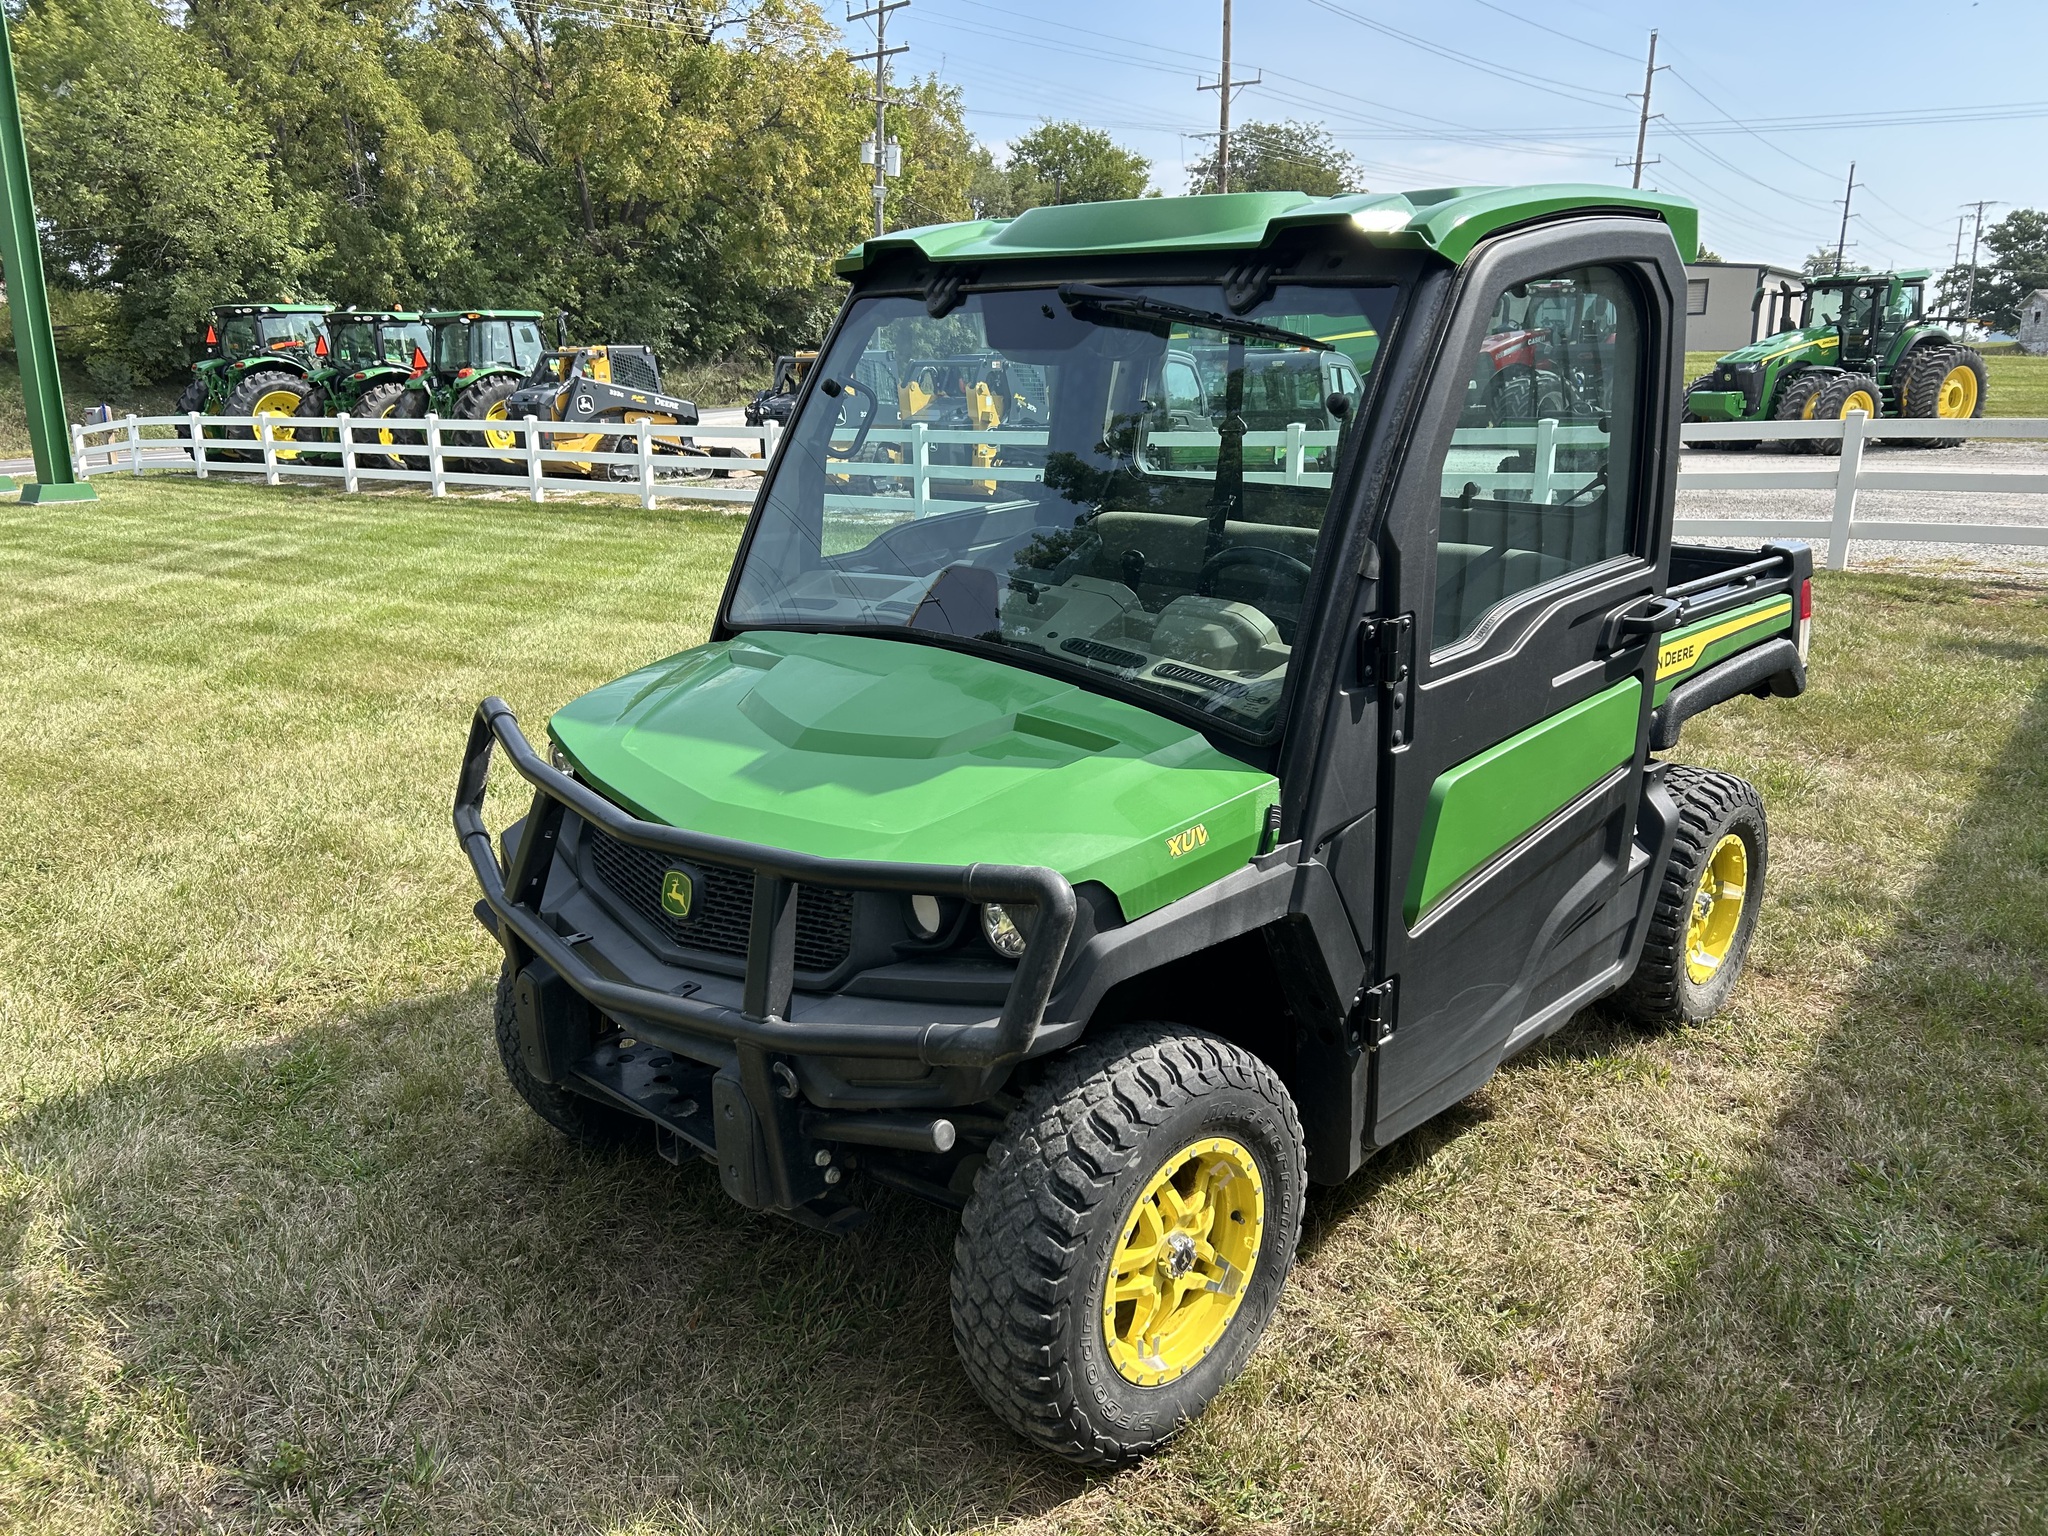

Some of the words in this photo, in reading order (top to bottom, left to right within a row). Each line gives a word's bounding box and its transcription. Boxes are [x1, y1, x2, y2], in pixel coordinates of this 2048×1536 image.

[655, 397, 680, 410] DEERE
[1665, 645, 1694, 667] DEERE
[1167, 824, 1207, 857] XUV
[1079, 1229, 1159, 1433] BFGoodrich
